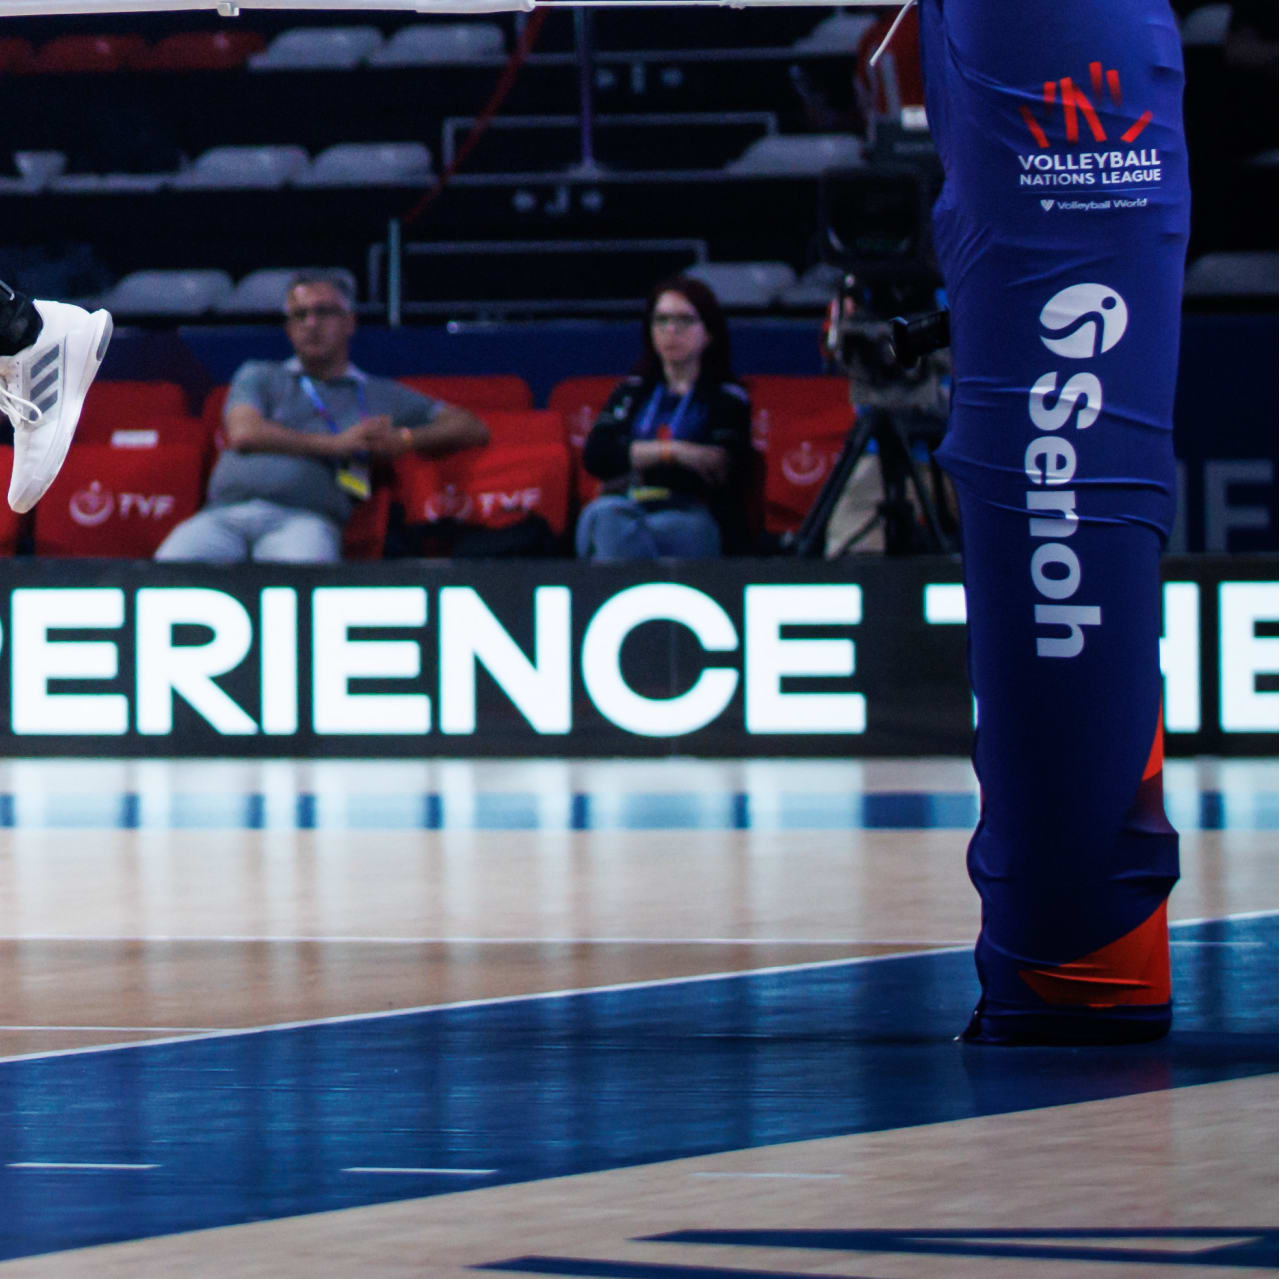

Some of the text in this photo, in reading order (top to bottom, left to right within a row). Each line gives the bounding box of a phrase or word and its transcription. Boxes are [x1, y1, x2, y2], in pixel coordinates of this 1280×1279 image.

[1018, 148, 1161, 171] VOLLEYBALL
[1019, 168, 1161, 186] NATIONS LEAGUE
[1057, 197, 1148, 211] Volleyball World
[118, 493, 175, 521] TVF
[1024, 370, 1103, 659] Senoh
